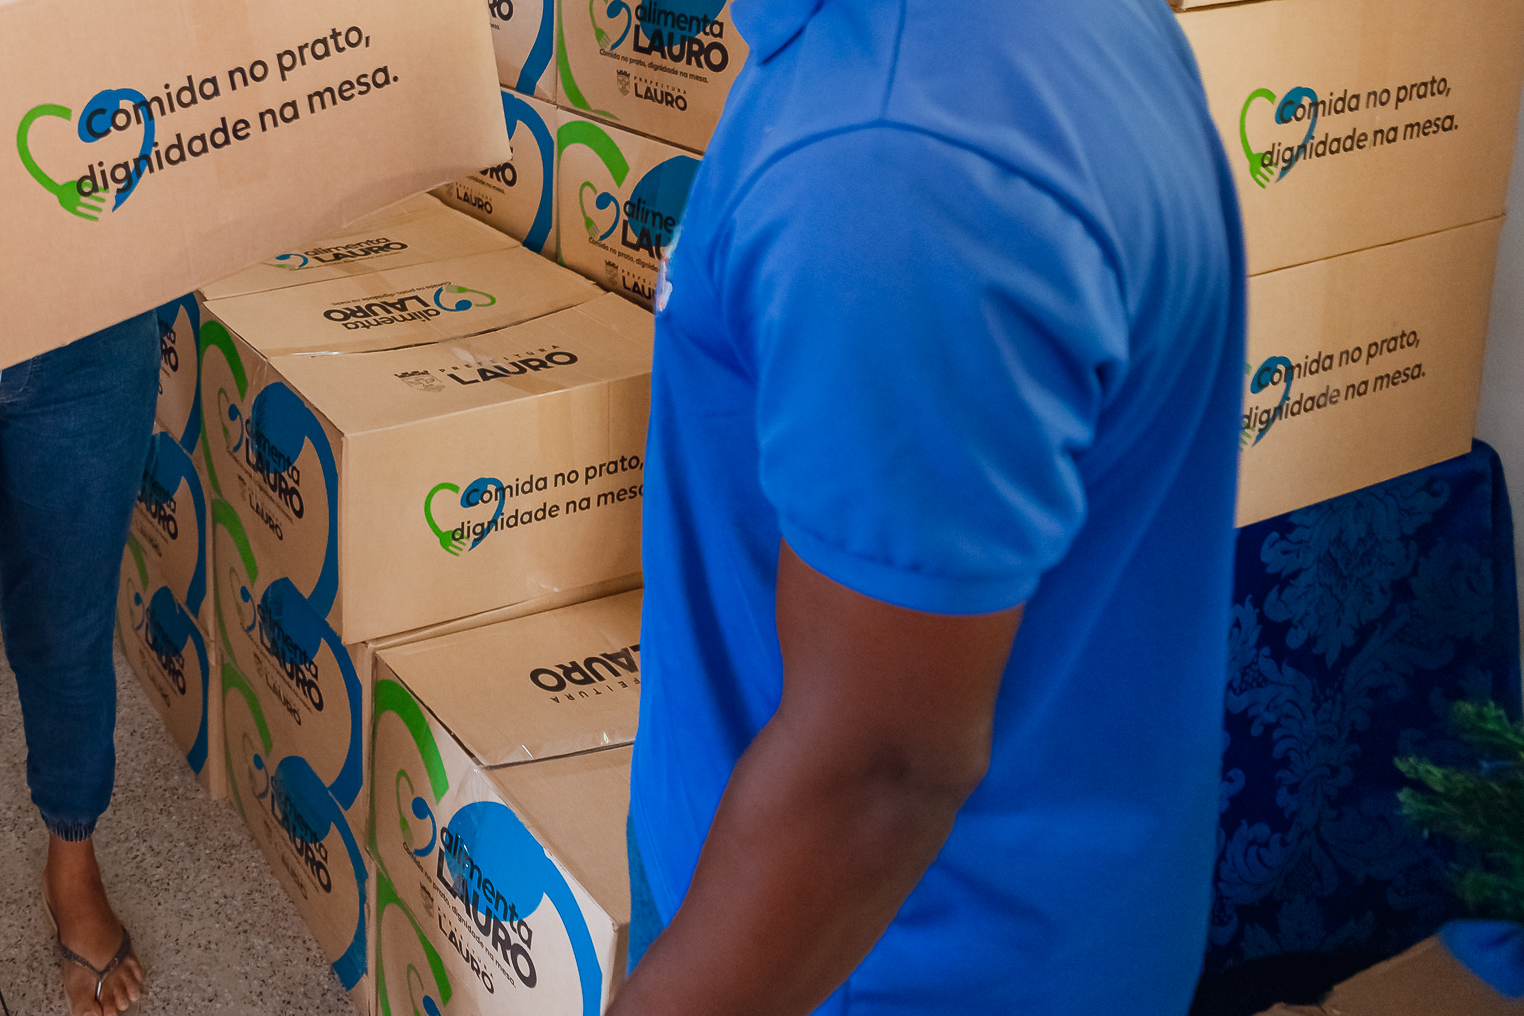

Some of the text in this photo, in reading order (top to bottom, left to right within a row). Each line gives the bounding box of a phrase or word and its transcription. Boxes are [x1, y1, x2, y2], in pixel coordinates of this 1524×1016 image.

[635, 0, 725, 39] alimenta
[621, 55, 628, 63] no
[629, 56, 647, 68] prato,
[648, 61, 678, 75] dignidade
[689, 73, 709, 84] mesa.
[633, 24, 729, 73] LAURO
[85, 24, 372, 141] Comida no prato,
[634, 82, 688, 112] LAURO
[1279, 74, 1452, 125] Comida no prato,
[76, 64, 401, 198] dignidade na mesa.
[1260, 110, 1460, 173] dignidade na mesa.
[456, 187, 493, 214] LAURO
[623, 197, 676, 233] alime
[304, 237, 391, 256] alimenta
[312, 241, 408, 263] LAURO
[609, 247, 617, 255] no
[323, 295, 430, 322] LAURO
[622, 275, 655, 300] LAU
[341, 308, 440, 330] alimenta
[447, 351, 578, 386] LAURO
[1256, 328, 1420, 391] Comida no prato,
[1241, 361, 1427, 431] dignidade na mesa.
[245, 437, 305, 519] LAURO
[466, 455, 644, 507] Comida no prato,
[248, 493, 284, 541] LAURO
[451, 502, 560, 543] dignidade
[565, 497, 591, 515] na
[259, 620, 324, 712] LAURO
[271, 794, 332, 894] LAURO
[440, 826, 533, 950] alimenta
[432, 881, 451, 909] prato,
[451, 906, 485, 949] dignidade
[484, 947, 495, 962] na
[494, 961, 517, 989] mesa.
[436, 846, 538, 989] LAURO
[437, 913, 495, 995] LAURO
